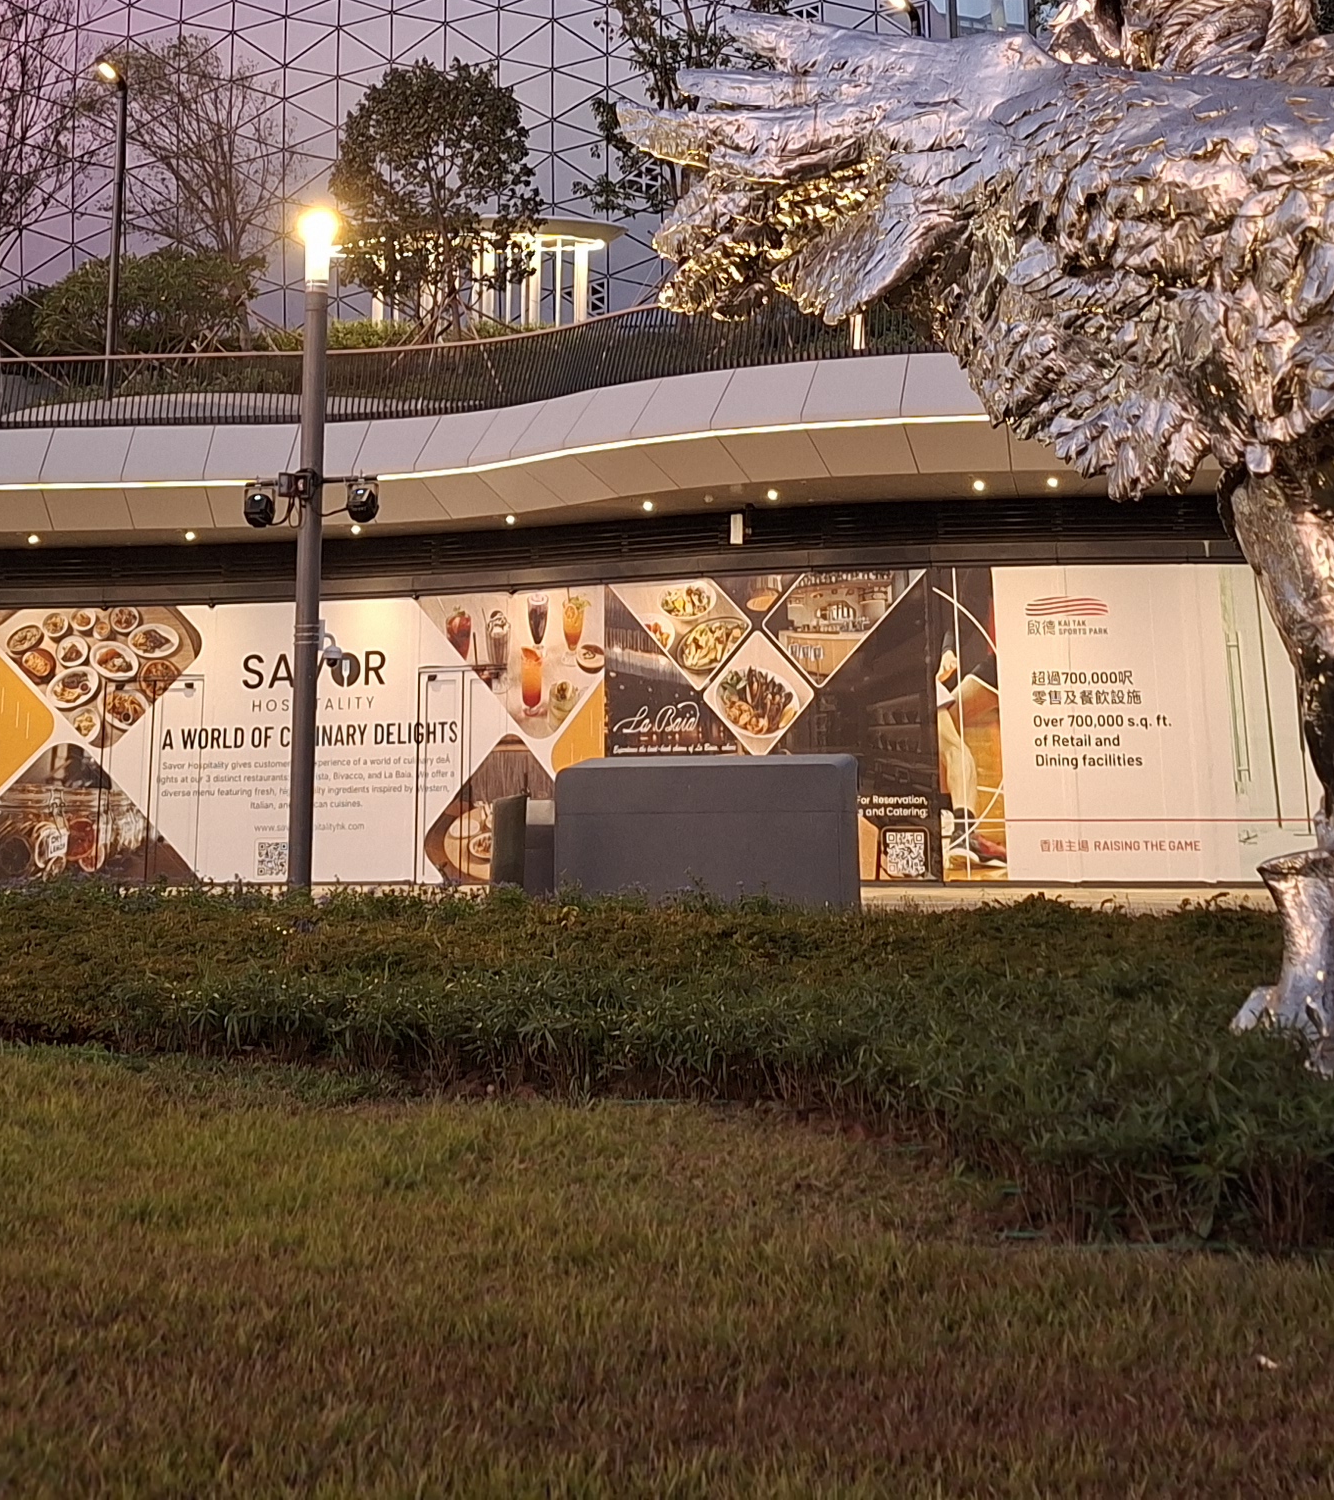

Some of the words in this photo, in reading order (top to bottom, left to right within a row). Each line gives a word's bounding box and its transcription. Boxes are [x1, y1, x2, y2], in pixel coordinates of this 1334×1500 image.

[1032, 670, 1133, 685] 超過700,000呎
[252, 696, 375, 712] HOSALITY
[1032, 689, 1142, 705] 零售及餐飲設施
[613, 706, 652, 733] La
[1033, 715, 1064, 727] Over
[1068, 714, 1124, 729] 700,000
[1128, 716, 1152, 730] s.q.
[1156, 714, 1172, 727] ft.
[162, 728, 174, 750] A
[181, 727, 245, 750] WORLD
[251, 726, 275, 748] OF
[280, 723, 368, 748] CINARY
[374, 721, 458, 745] DELIGHTS
[1034, 735, 1048, 747] of
[1052, 734, 1091, 747] Retail
[1095, 734, 1120, 747] and
[162, 761, 185, 770] Savor
[188, 760, 228, 771] Hospitality
[231, 760, 252, 770] gives
[254, 760, 290, 768] customer
[353, 757, 361, 765] of
[370, 757, 391, 765] world
[393, 756, 401, 765] of
[1036, 754, 1078, 770] Dining
[1082, 753, 1143, 767] facilities
[180, 775, 188, 783] at
[206, 775, 210, 783] 3
[213, 774, 241, 783] distinct
[333, 771, 366, 781] Bivacco,
[367, 770, 382, 779] and
[384, 770, 393, 779] La
[431, 769, 448, 778] offer
[161, 788, 191, 797] diverse
[193, 789, 215, 797] menu
[217, 788, 252, 797] featuring
[255, 787, 277, 797] fresh,
[328, 785, 369, 796] ingredients
[372, 785, 402, 795] inspired
[404, 784, 414, 794] by
[250, 801, 276, 810] Italian,
[873, 794, 927, 805] Reservation,
[866, 807, 884, 816] and
[1094, 840, 1140, 851] RAISING
[1143, 840, 1166, 851] THE
[1168, 840, 1201, 851] GAME
